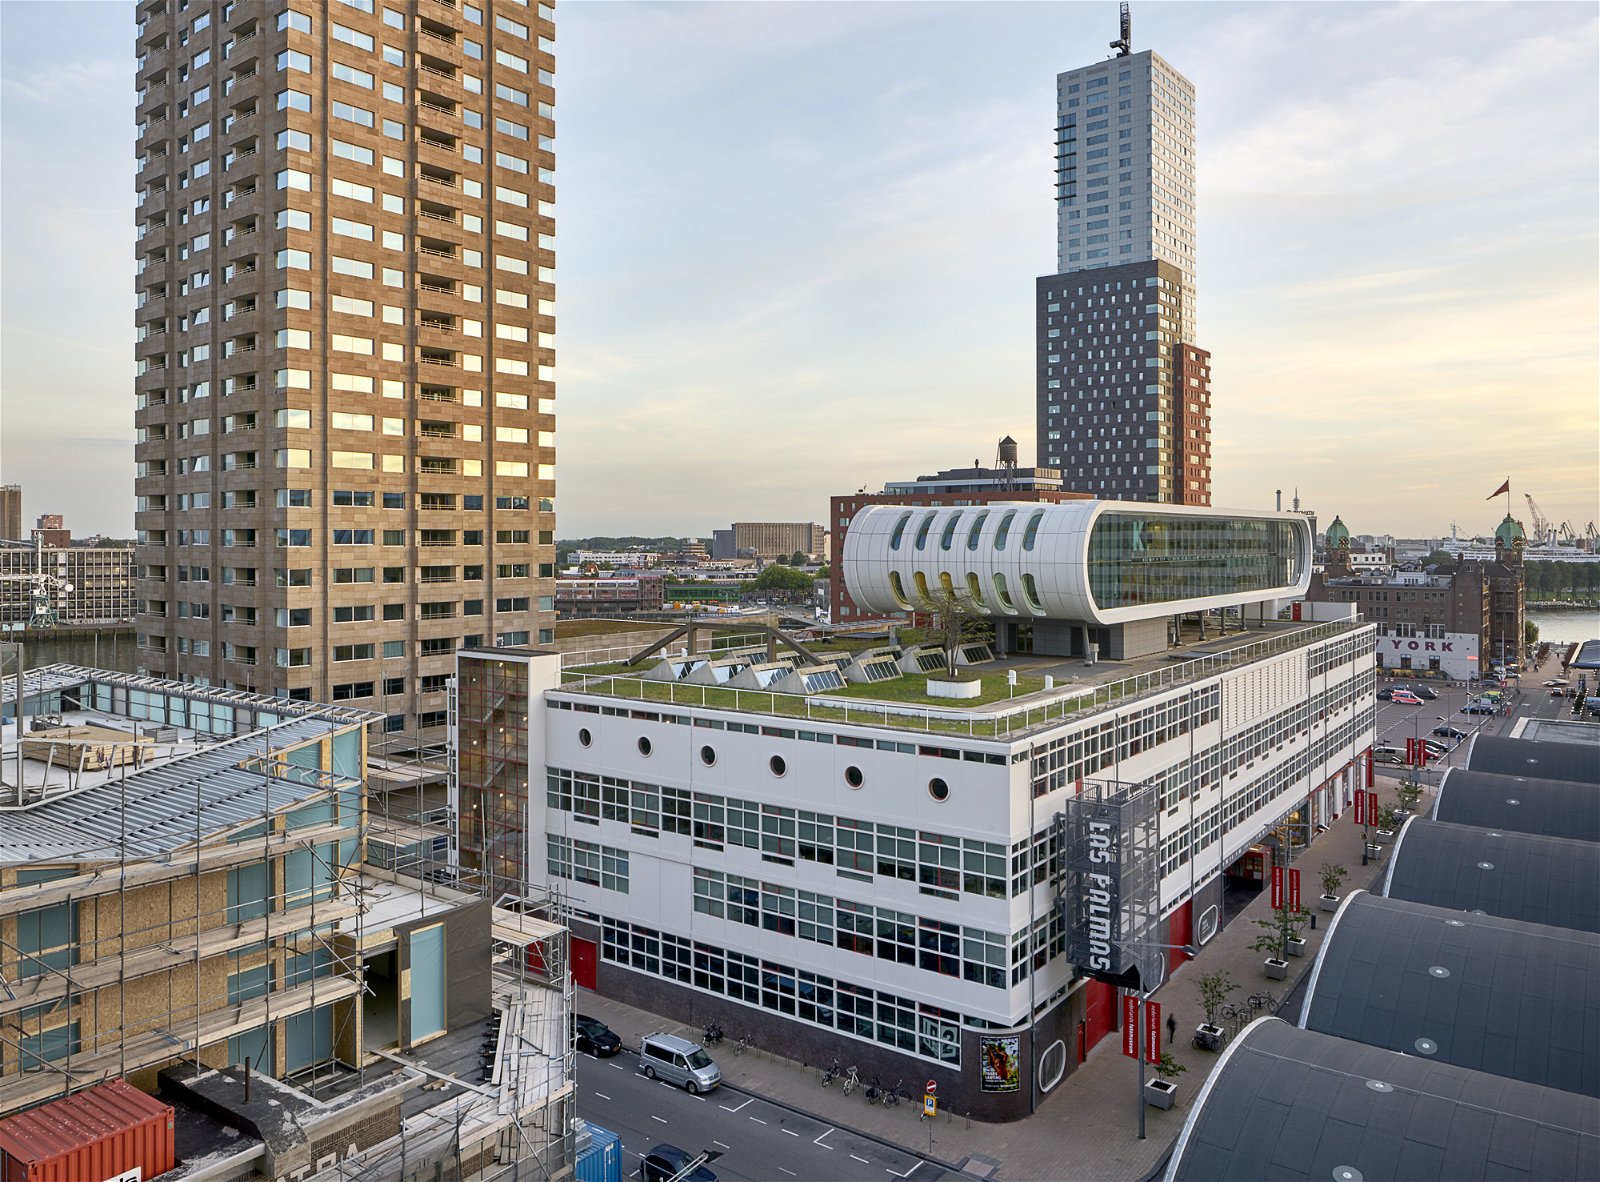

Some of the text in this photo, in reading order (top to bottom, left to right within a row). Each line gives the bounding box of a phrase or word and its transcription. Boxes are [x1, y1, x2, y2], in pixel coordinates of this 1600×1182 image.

[1391, 640, 1454, 652] YORK
[1089, 821, 1111, 971] LAS PALMAS
